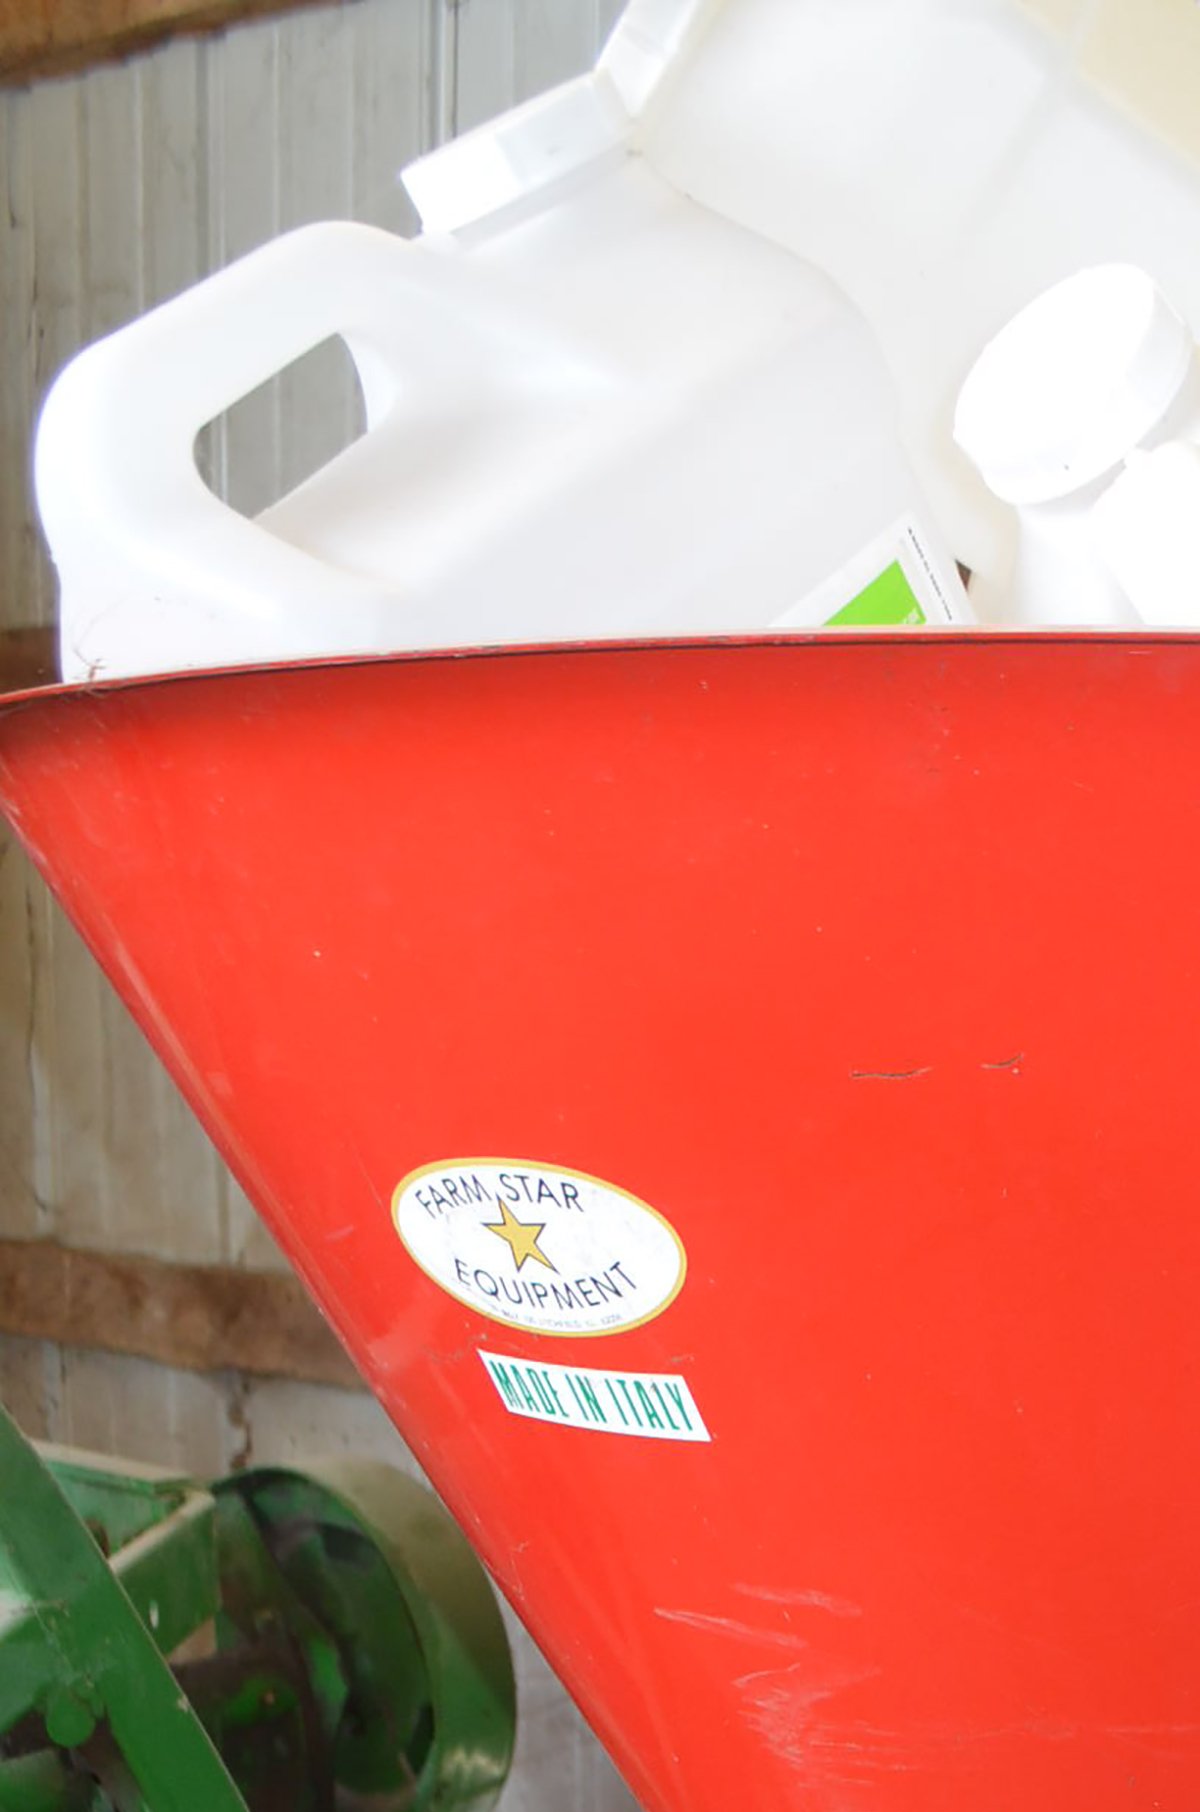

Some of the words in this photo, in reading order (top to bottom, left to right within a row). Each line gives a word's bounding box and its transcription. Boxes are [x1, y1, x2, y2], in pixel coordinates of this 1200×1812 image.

[415, 1174, 492, 1220] FARM
[498, 1173, 585, 1213] STAR
[453, 1260, 638, 1310] EQUIPMENT
[489, 1359, 570, 1418] MADE
[564, 1372, 608, 1424] IN
[604, 1377, 693, 1432] ITALY
